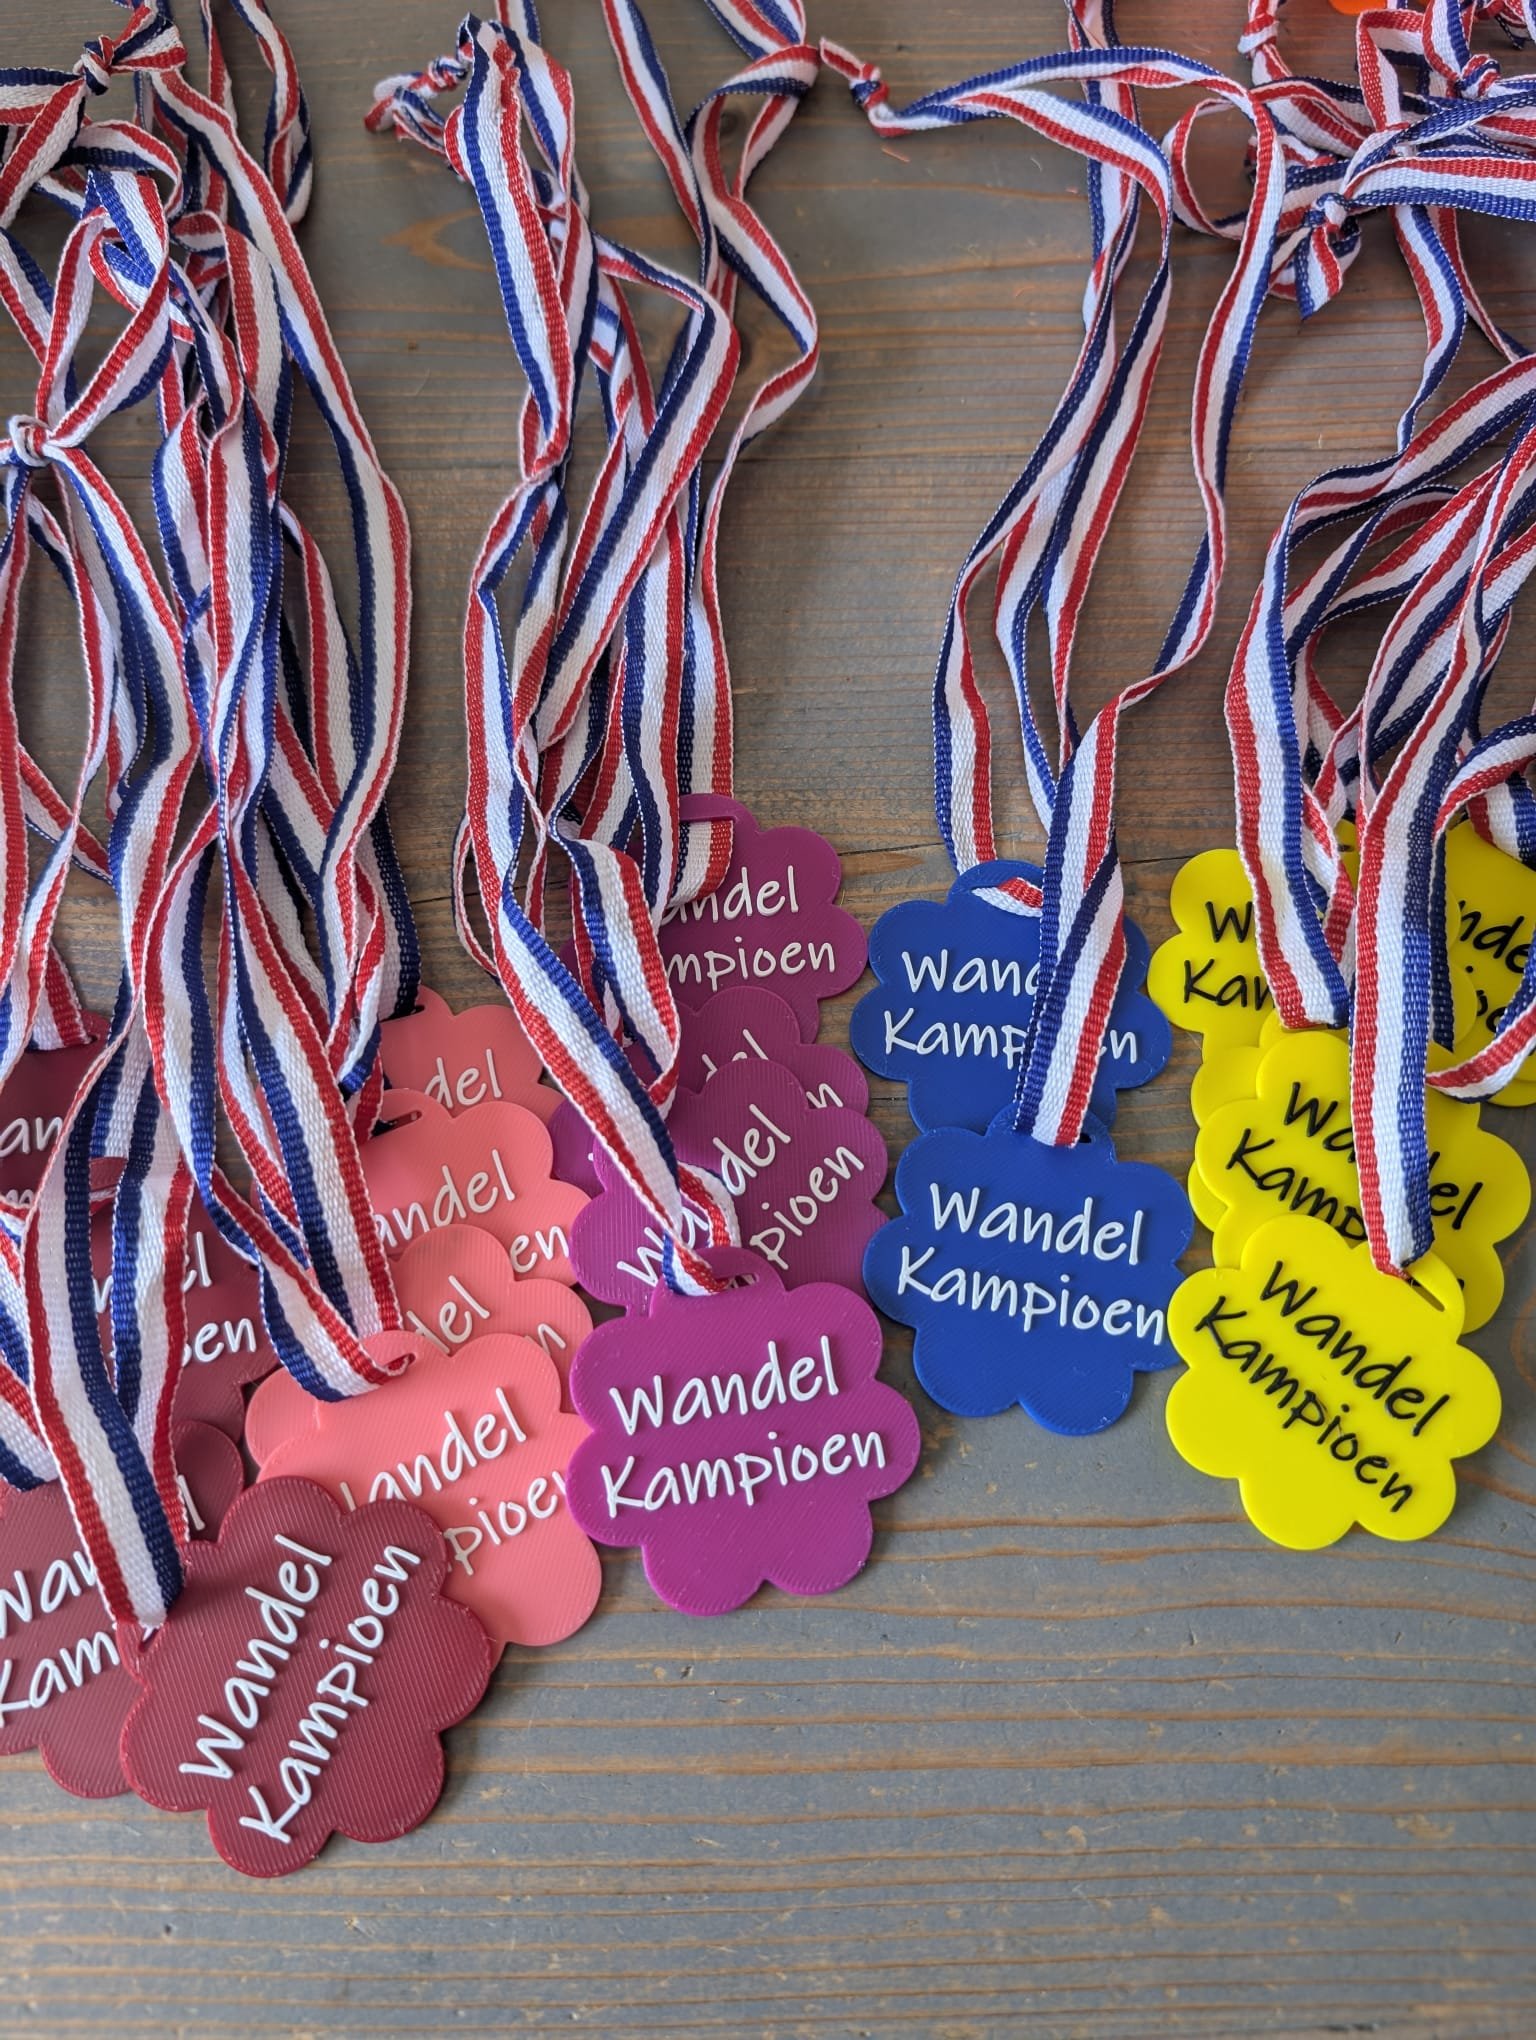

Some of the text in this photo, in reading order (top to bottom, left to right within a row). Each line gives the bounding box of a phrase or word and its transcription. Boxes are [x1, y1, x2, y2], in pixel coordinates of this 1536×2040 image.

[666, 935, 836, 992] mpioen
[901, 948, 1041, 997] Wan
[424, 1048, 502, 1109] del
[883, 1007, 1138, 1070] Kampn
[374, 1148, 516, 1248] andel
[749, 1146, 865, 1270] pioen
[929, 1182, 1146, 1267] Wandel
[1226, 1128, 1368, 1241] Kamp
[897, 1245, 1166, 1346] Kampioen
[609, 1334, 840, 1436] Wandel
[1259, 1260, 1451, 1437] Wandel
[1194, 1295, 1415, 1514] Kampioen
[443, 1470, 568, 1577] pioe
[601, 1430, 887, 1519] Kampioen
[178, 1533, 333, 1781] Wandel
[239, 1544, 422, 1845] Kampioen
